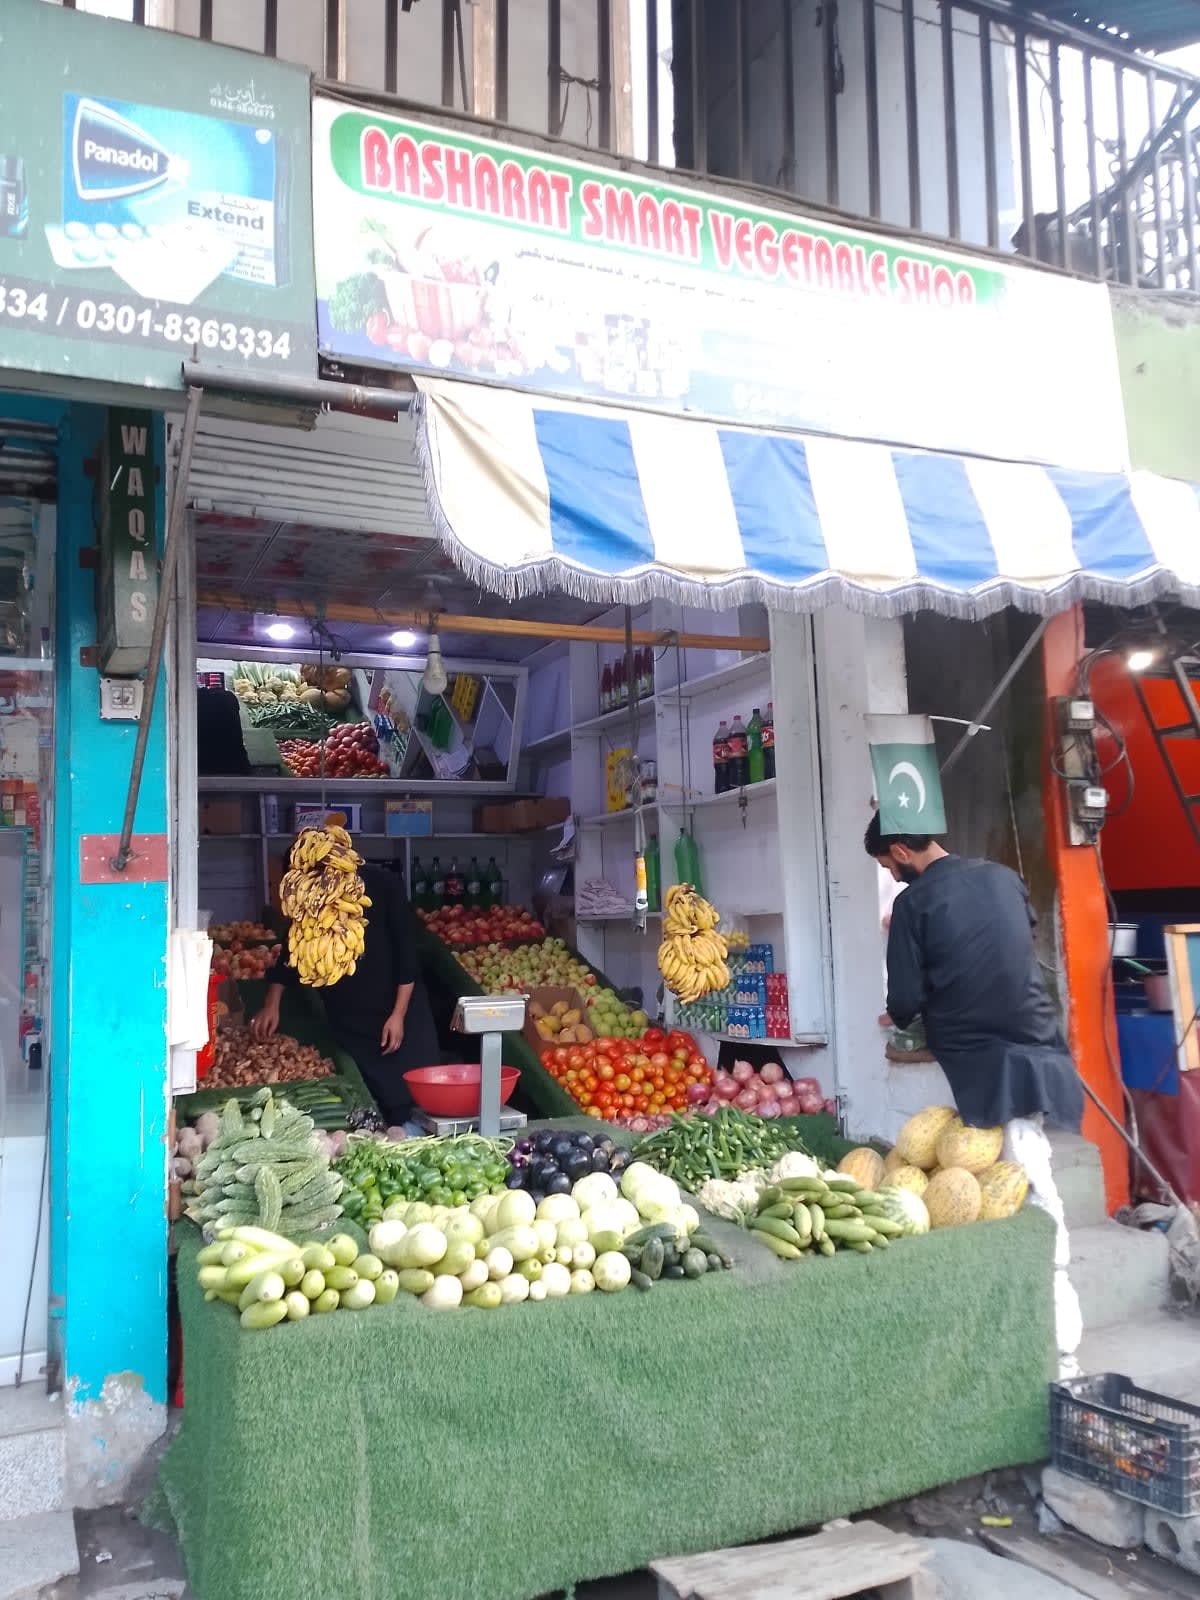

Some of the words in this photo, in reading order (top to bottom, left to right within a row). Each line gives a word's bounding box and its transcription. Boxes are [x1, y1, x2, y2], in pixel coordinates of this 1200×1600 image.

[84, 140, 158, 172] Panadol
[187, 199, 264, 231] Extend
[363, 129, 570, 229] BASHARAT
[582, 183, 700, 259] SMART
[711, 213, 887, 300] VEGETABLE
[897, 259, 975, 304] SHOP
[0, 286, 48, 321] 34
[76, 299, 291, 359] 0301-8363334
[120, 424, 148, 623] WAQAS
